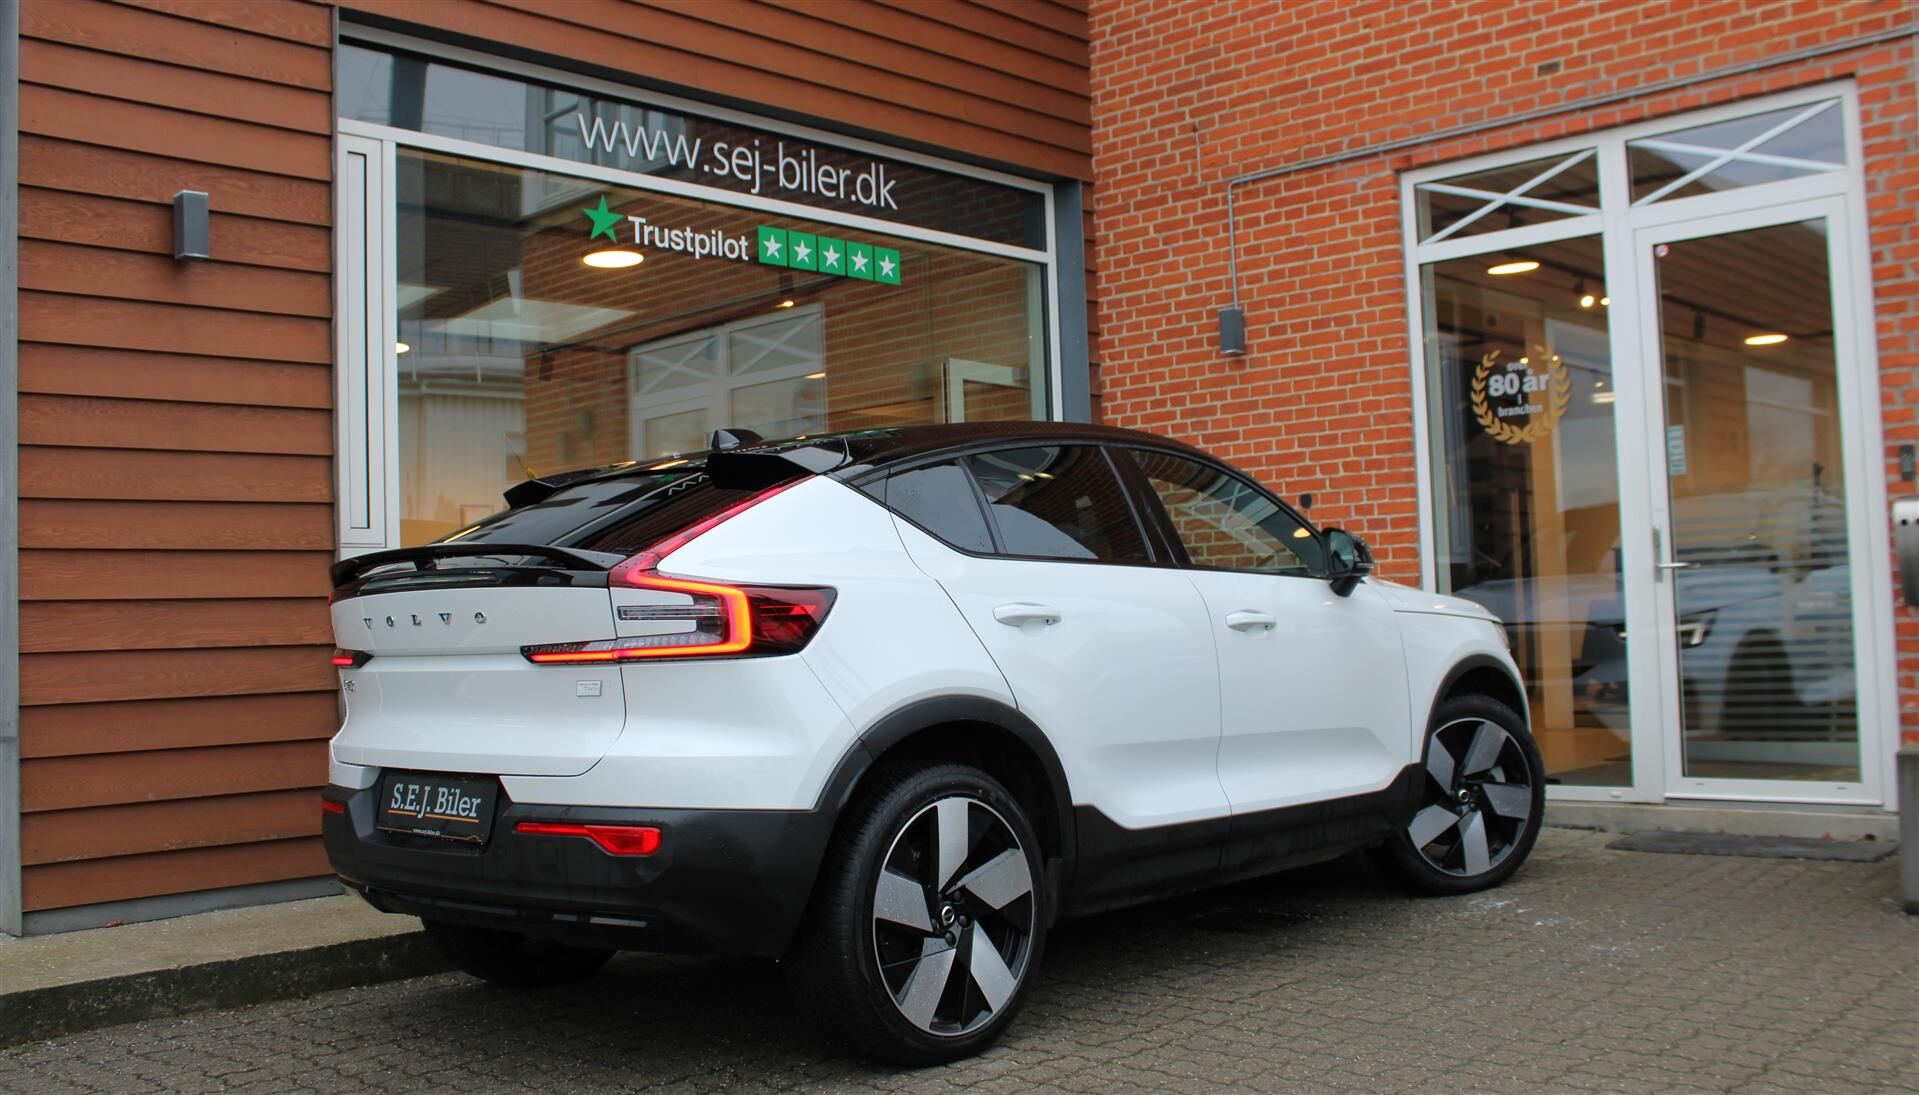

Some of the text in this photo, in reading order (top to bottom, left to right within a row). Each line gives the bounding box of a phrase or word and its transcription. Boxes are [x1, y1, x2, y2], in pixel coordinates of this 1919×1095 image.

[577, 113, 898, 210] www.sej-biler.dk
[627, 215, 749, 261] Trustpilot
[1506, 362, 1528, 371] over
[1488, 367, 1550, 397] 80 år
[1497, 403, 1543, 417] branchen
[363, 611, 487, 629] VOLVO
[390, 783, 482, 819] S.E.J. Biler
